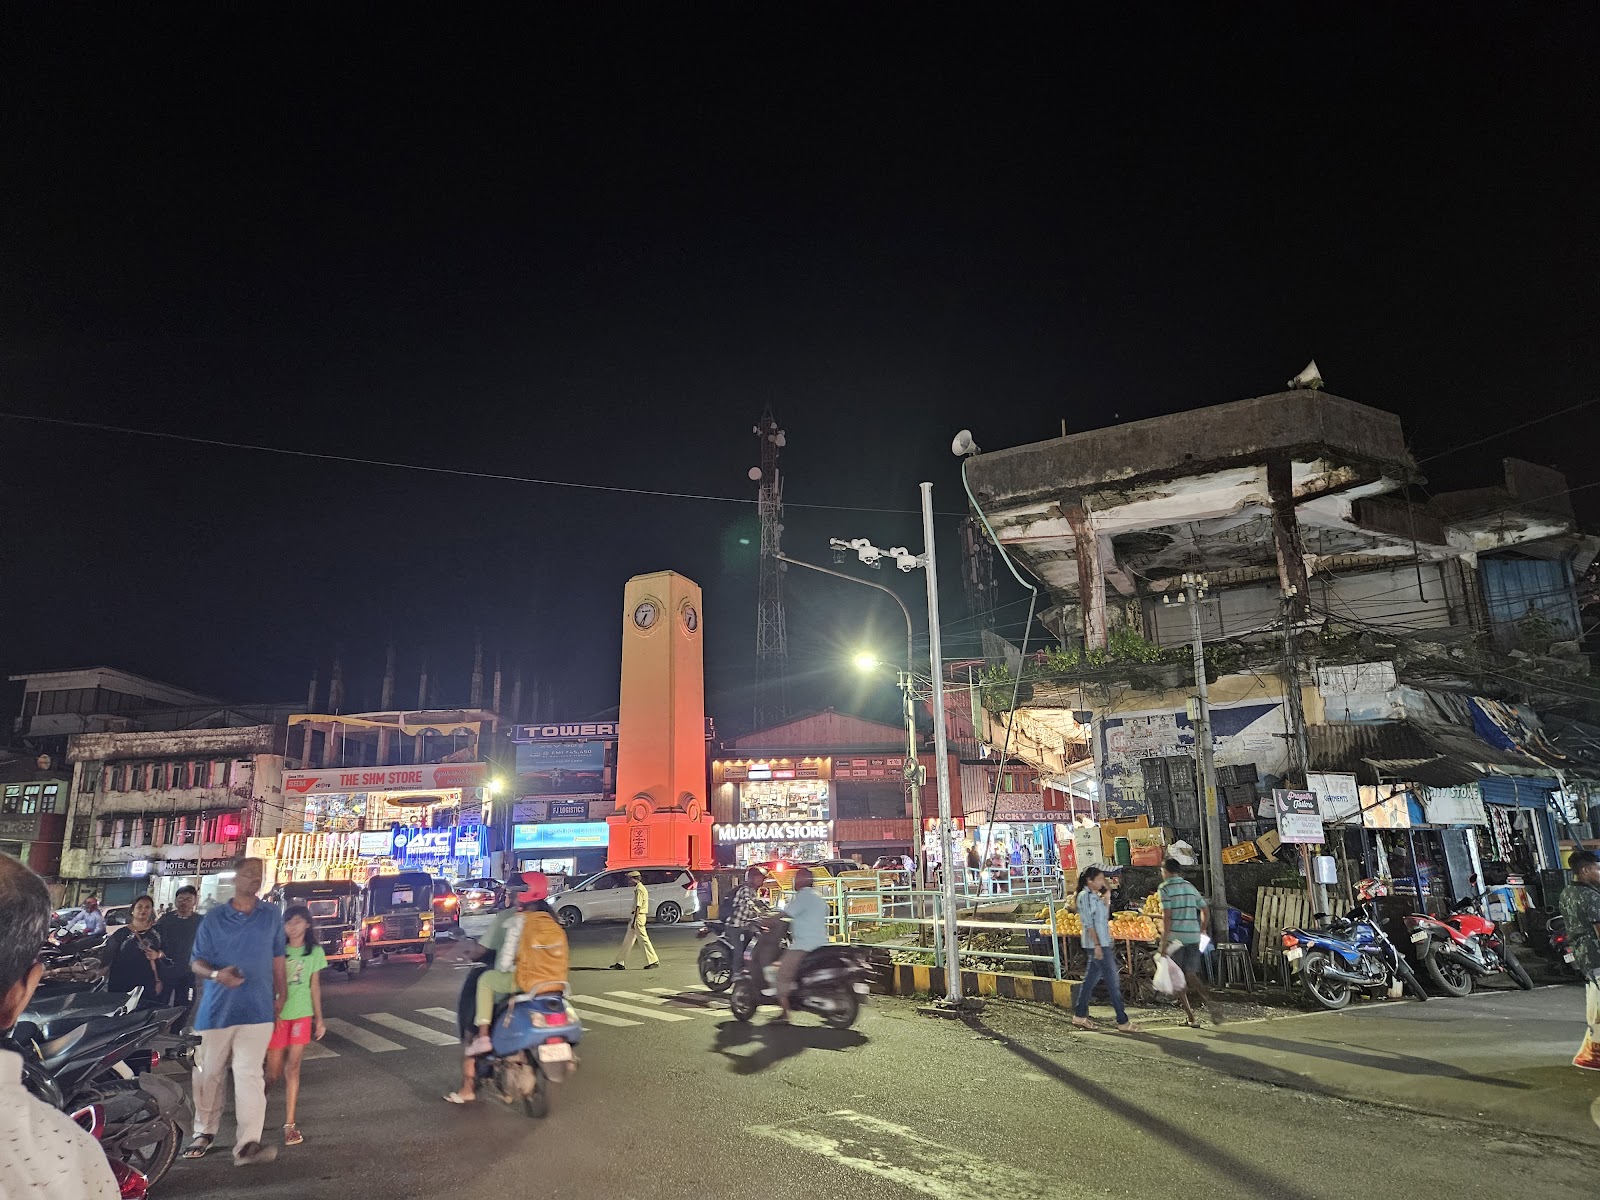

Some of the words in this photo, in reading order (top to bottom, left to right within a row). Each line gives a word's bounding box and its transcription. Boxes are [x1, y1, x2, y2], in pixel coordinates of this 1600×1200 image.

[524, 724, 619, 737] TOWER
[340, 773, 359, 786] THE
[362, 772, 385, 785] SHM
[388, 770, 422, 784] STORE
[1450, 786, 1478, 799] STORE
[553, 806, 559, 814] FJ
[560, 806, 584, 814] LOGISTICS
[1032, 812, 1071, 820] CLOTH
[719, 826, 785, 840] MUBARAK
[786, 825, 828, 839] STORE
[406, 833, 452, 848] ATC
[187, 861, 211, 869] BECH
